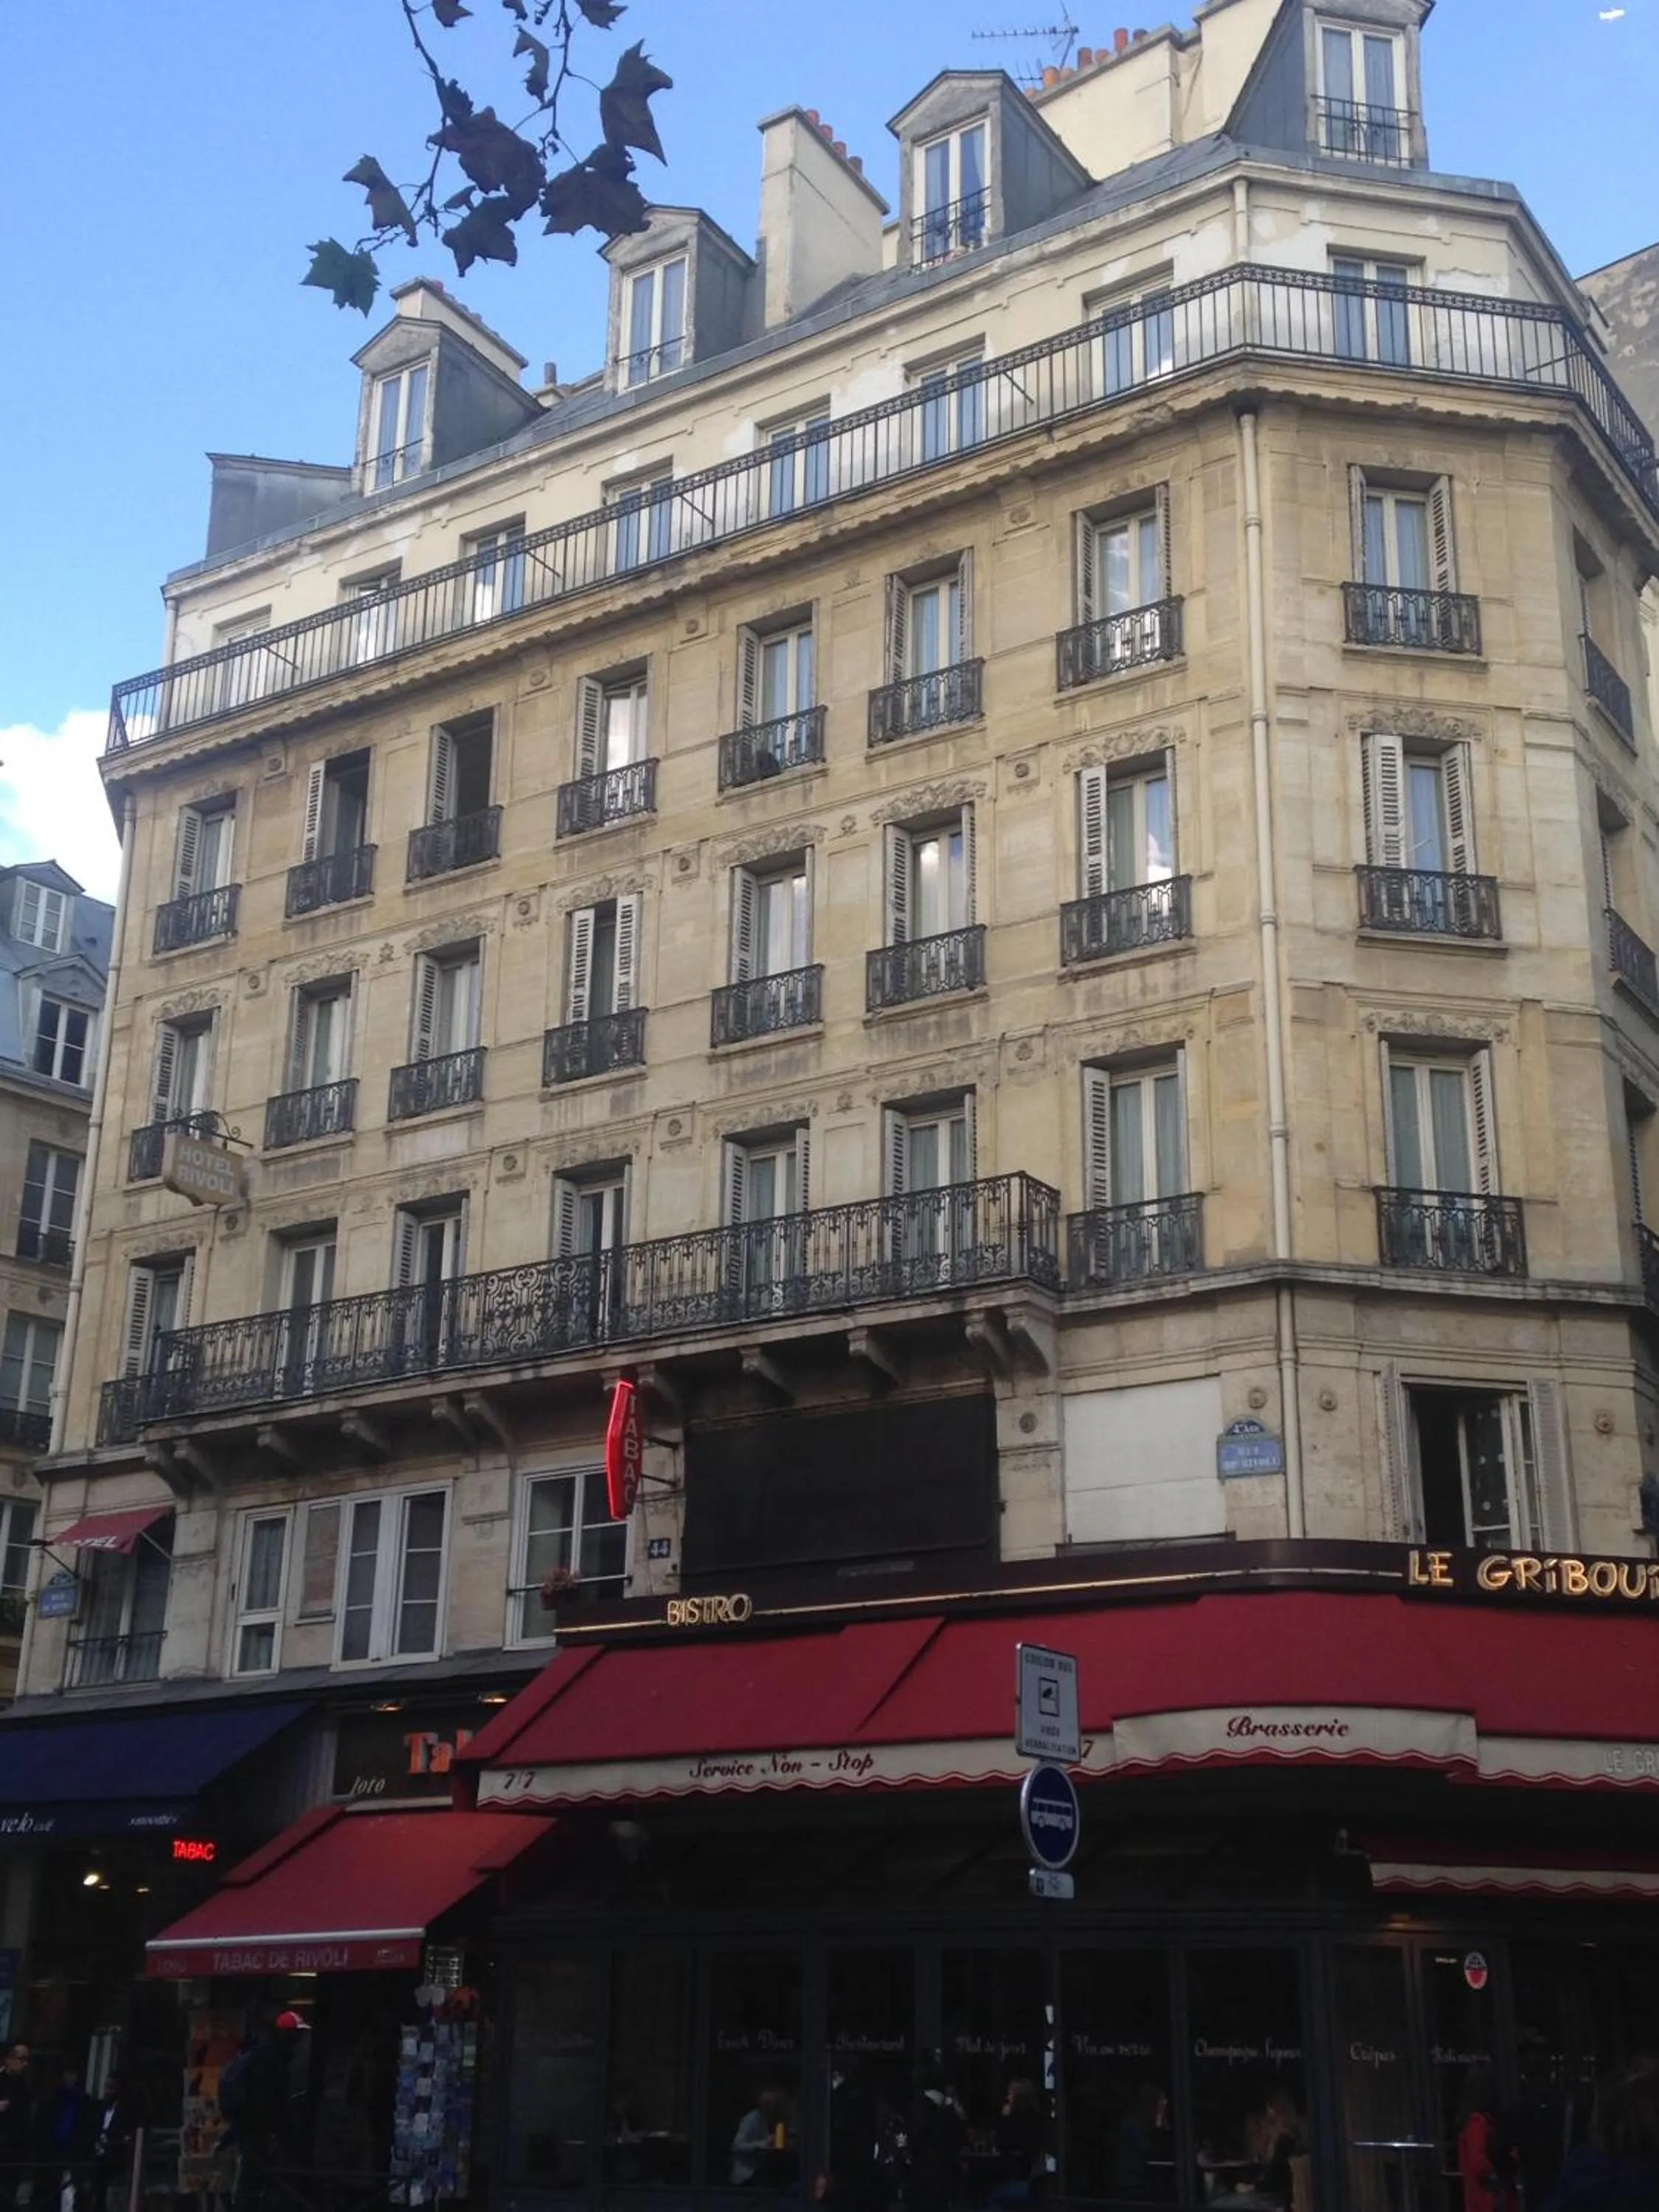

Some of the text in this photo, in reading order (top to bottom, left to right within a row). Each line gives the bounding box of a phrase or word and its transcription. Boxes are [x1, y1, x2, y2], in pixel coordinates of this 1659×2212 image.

[178, 1144, 234, 1177] HOTEL
[178, 1165, 235, 1195] RIVOLI
[623, 1394, 639, 1505] TABAC
[649, 1540, 669, 1558] 44
[1408, 1549, 1455, 1587] LE
[667, 1593, 753, 1627] BISTRO
[1226, 1716, 1352, 1738] Brasserie
[404, 1729, 473, 1774] Ta
[689, 1758, 754, 1778] Service
[760, 1751, 802, 1775] Non
[828, 1750, 874, 1777] Stop
[503, 1771, 536, 1790] 7/7
[172, 1840, 215, 1861] TABAC
[212, 1949, 348, 1971] TABAC DE RIVOLI
